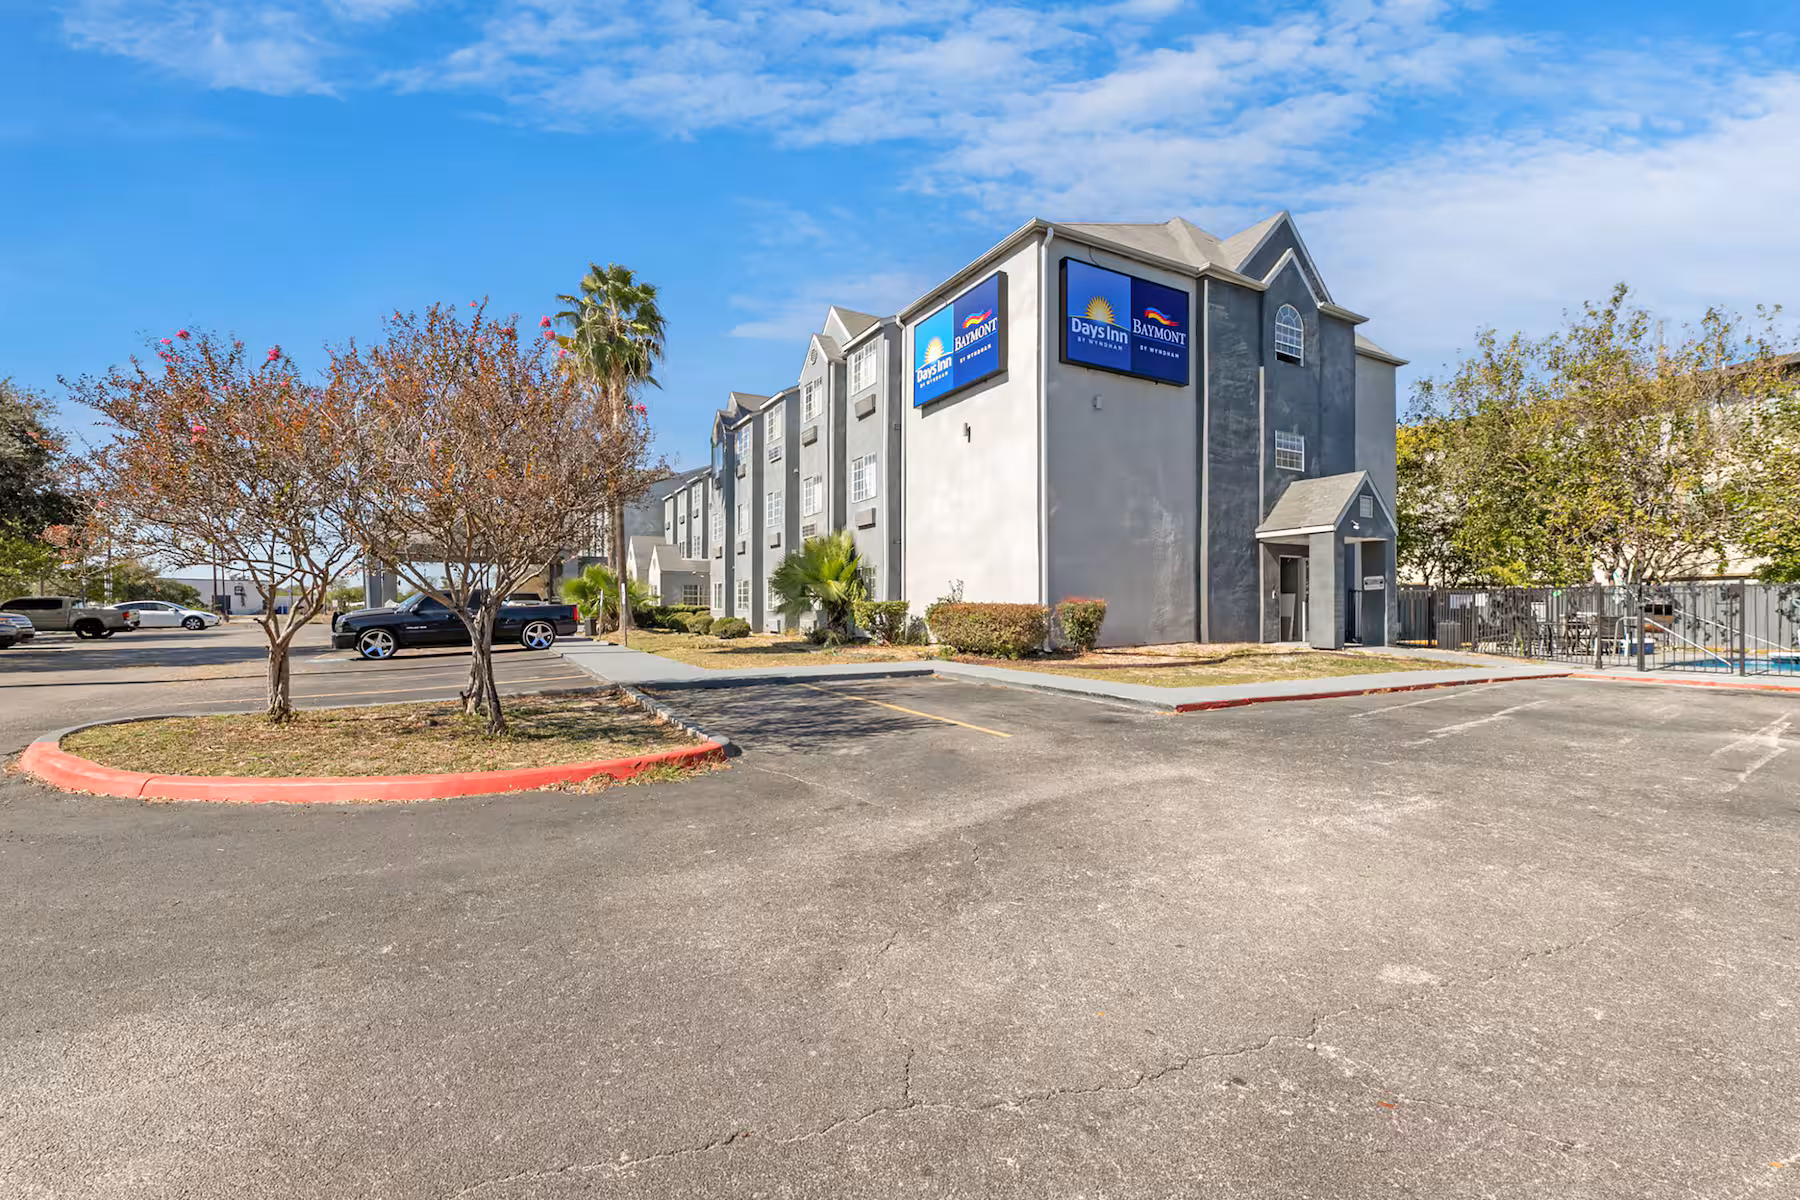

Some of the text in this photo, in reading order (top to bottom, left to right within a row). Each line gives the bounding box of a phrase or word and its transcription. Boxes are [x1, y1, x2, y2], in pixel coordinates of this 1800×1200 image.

[955, 317, 998, 352] BAYMONT
[1071, 317, 1128, 344] Days Inn
[1132, 318, 1186, 345] BAYMONT
[1088, 339, 1123, 351] WYNDHAM
[1139, 344, 1180, 359] BY WYNDHAM
[916, 356, 952, 383] Days Inn
